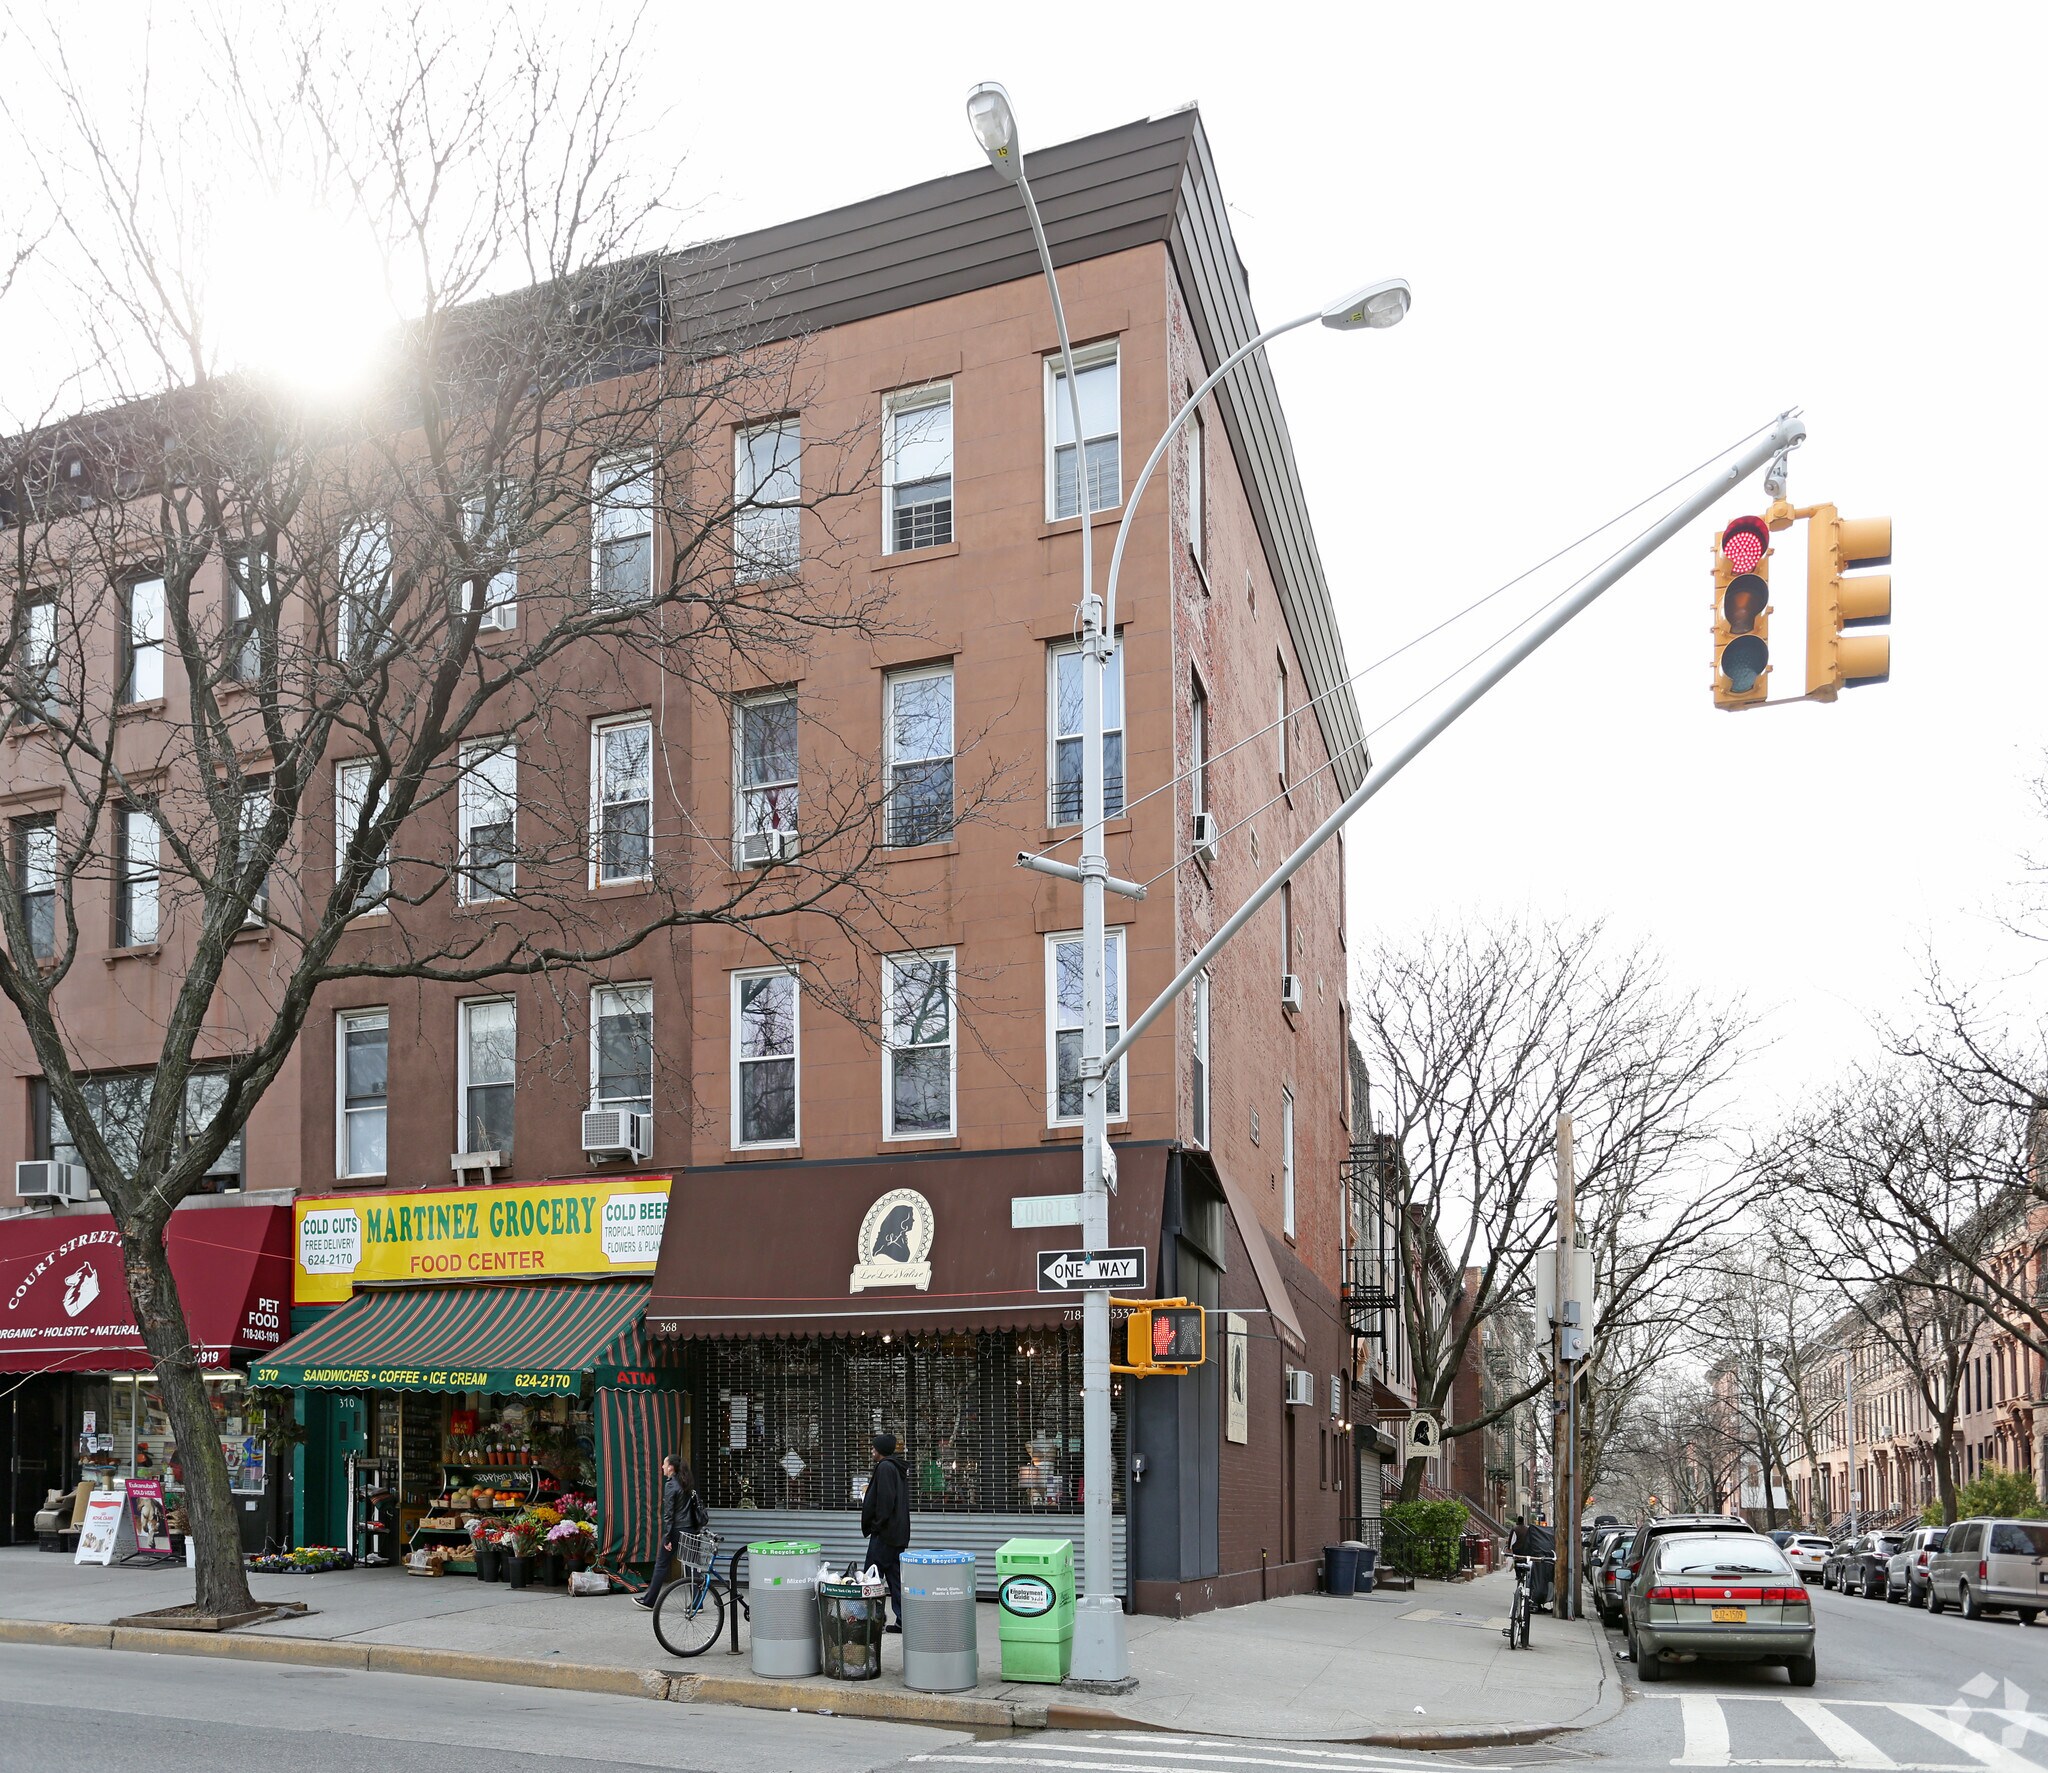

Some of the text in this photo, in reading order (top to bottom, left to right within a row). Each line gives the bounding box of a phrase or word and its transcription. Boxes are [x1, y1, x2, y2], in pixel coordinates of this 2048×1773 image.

[997, 145, 1008, 156] 15
[606, 1204, 636, 1221] COLD
[1015, 1200, 1061, 1223] COURT
[303, 1217, 358, 1235] COLD CUTS
[367, 1197, 596, 1243] MARTINEZ GROCERY
[605, 1224, 664, 1237] TROPICAL PRODUC
[305, 1238, 355, 1250] FREE DELIVERY
[607, 1240, 661, 1253] FLOWERS & PLAN
[308, 1253, 353, 1266] 624-2170
[410, 1251, 545, 1273] FOOD CENTER
[8, 1230, 119, 1310] COURT STREET
[1054, 1261, 1131, 1279] ONE WAY
[259, 1297, 279, 1313] PET
[249, 1311, 279, 1328] FOOD
[660, 1322, 677, 1332] 368
[0, 1324, 140, 1339] RGANIC HOLISTIC NATURAL
[242, 1327, 279, 1343] 718-243-1919
[258, 1369, 571, 1388] 370 SANDWICHES COFFEE ICE CREAM 624-2170
[617, 1371, 657, 1386] ATM
[128, 1481, 153, 1489] Eukanuba
[1010, 1588, 1043, 1597] Employment
